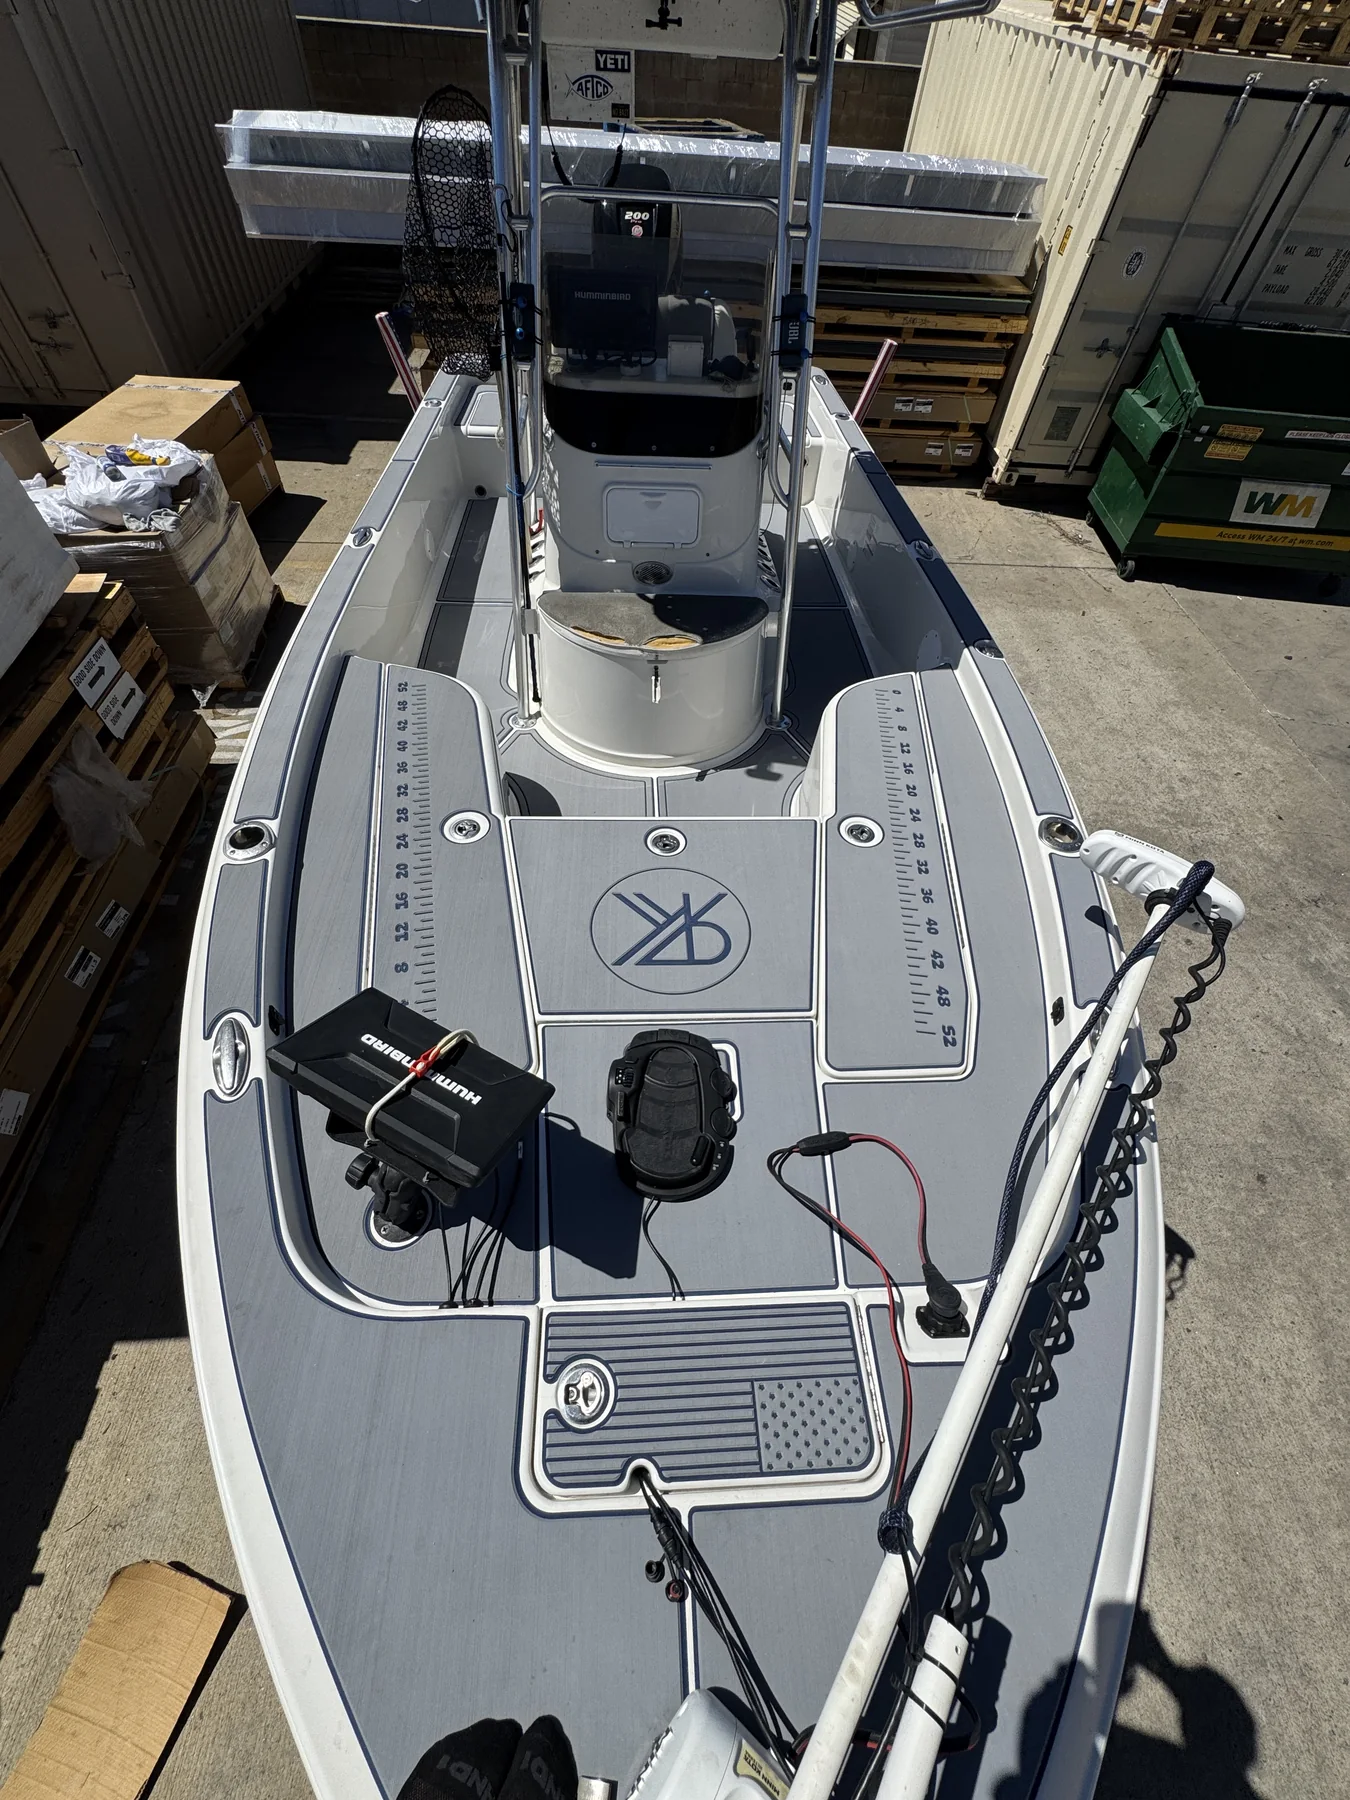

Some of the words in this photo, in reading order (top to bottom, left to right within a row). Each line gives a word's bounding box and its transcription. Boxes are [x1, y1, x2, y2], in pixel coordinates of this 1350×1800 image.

[596, 53, 629, 70] YETI
[575, 76, 610, 99] AFTCO
[624, 211, 650, 220] 200
[1283, 245, 1298, 255] MAX
[1304, 246, 1324, 258] GROSS
[1273, 264, 1289, 275] TARE
[574, 290, 631, 301] HUMMINBIRD
[1261, 283, 1290, 294] PAYLOAD
[787, 321, 800, 344] JBL
[1243, 491, 1318, 518] WM
[1216, 530, 1246, 540] Access
[1247, 533, 1267, 542] WM
[1266, 535, 1288, 544] 24/7
[1288, 537, 1298, 546] at
[1299, 538, 1334, 548] wm.com
[73, 670, 86, 688] GOOD
[85, 658, 96, 675] SIDE
[92, 643, 107, 663] DOWN
[397, 681, 408, 692] 52
[101, 703, 113, 720] GOOD
[110, 694, 120, 708] SIDE
[397, 700, 408, 711] 48
[110, 711, 123, 726] DOWN
[397, 719, 408, 731] 42
[396, 740, 408, 752] 40
[900, 742, 911, 754] 12
[396, 761, 409, 774] 36
[903, 762, 914, 775] 16
[396, 783, 409, 798] 32
[906, 784, 917, 797] 20
[396, 807, 409, 823] 28
[909, 808, 921, 823] 24
[396, 833, 409, 850] 24
[913, 832, 925, 849] 28
[395, 863, 409, 879] 20
[917, 859, 929, 875] 32
[395, 892, 409, 910] 16
[921, 888, 934, 904] 36
[394, 921, 409, 942] 12
[925, 917, 939, 935] 40
[930, 950, 944, 969] 42
[394, 962, 409, 974] 8
[936, 985, 951, 1007] 48
[941, 1024, 958, 1048] 52
[360, 1033, 483, 1106] HUMMNBIRD
[743, 1755, 762, 1777] KOTA
[761, 1773, 780, 1796] MINN
